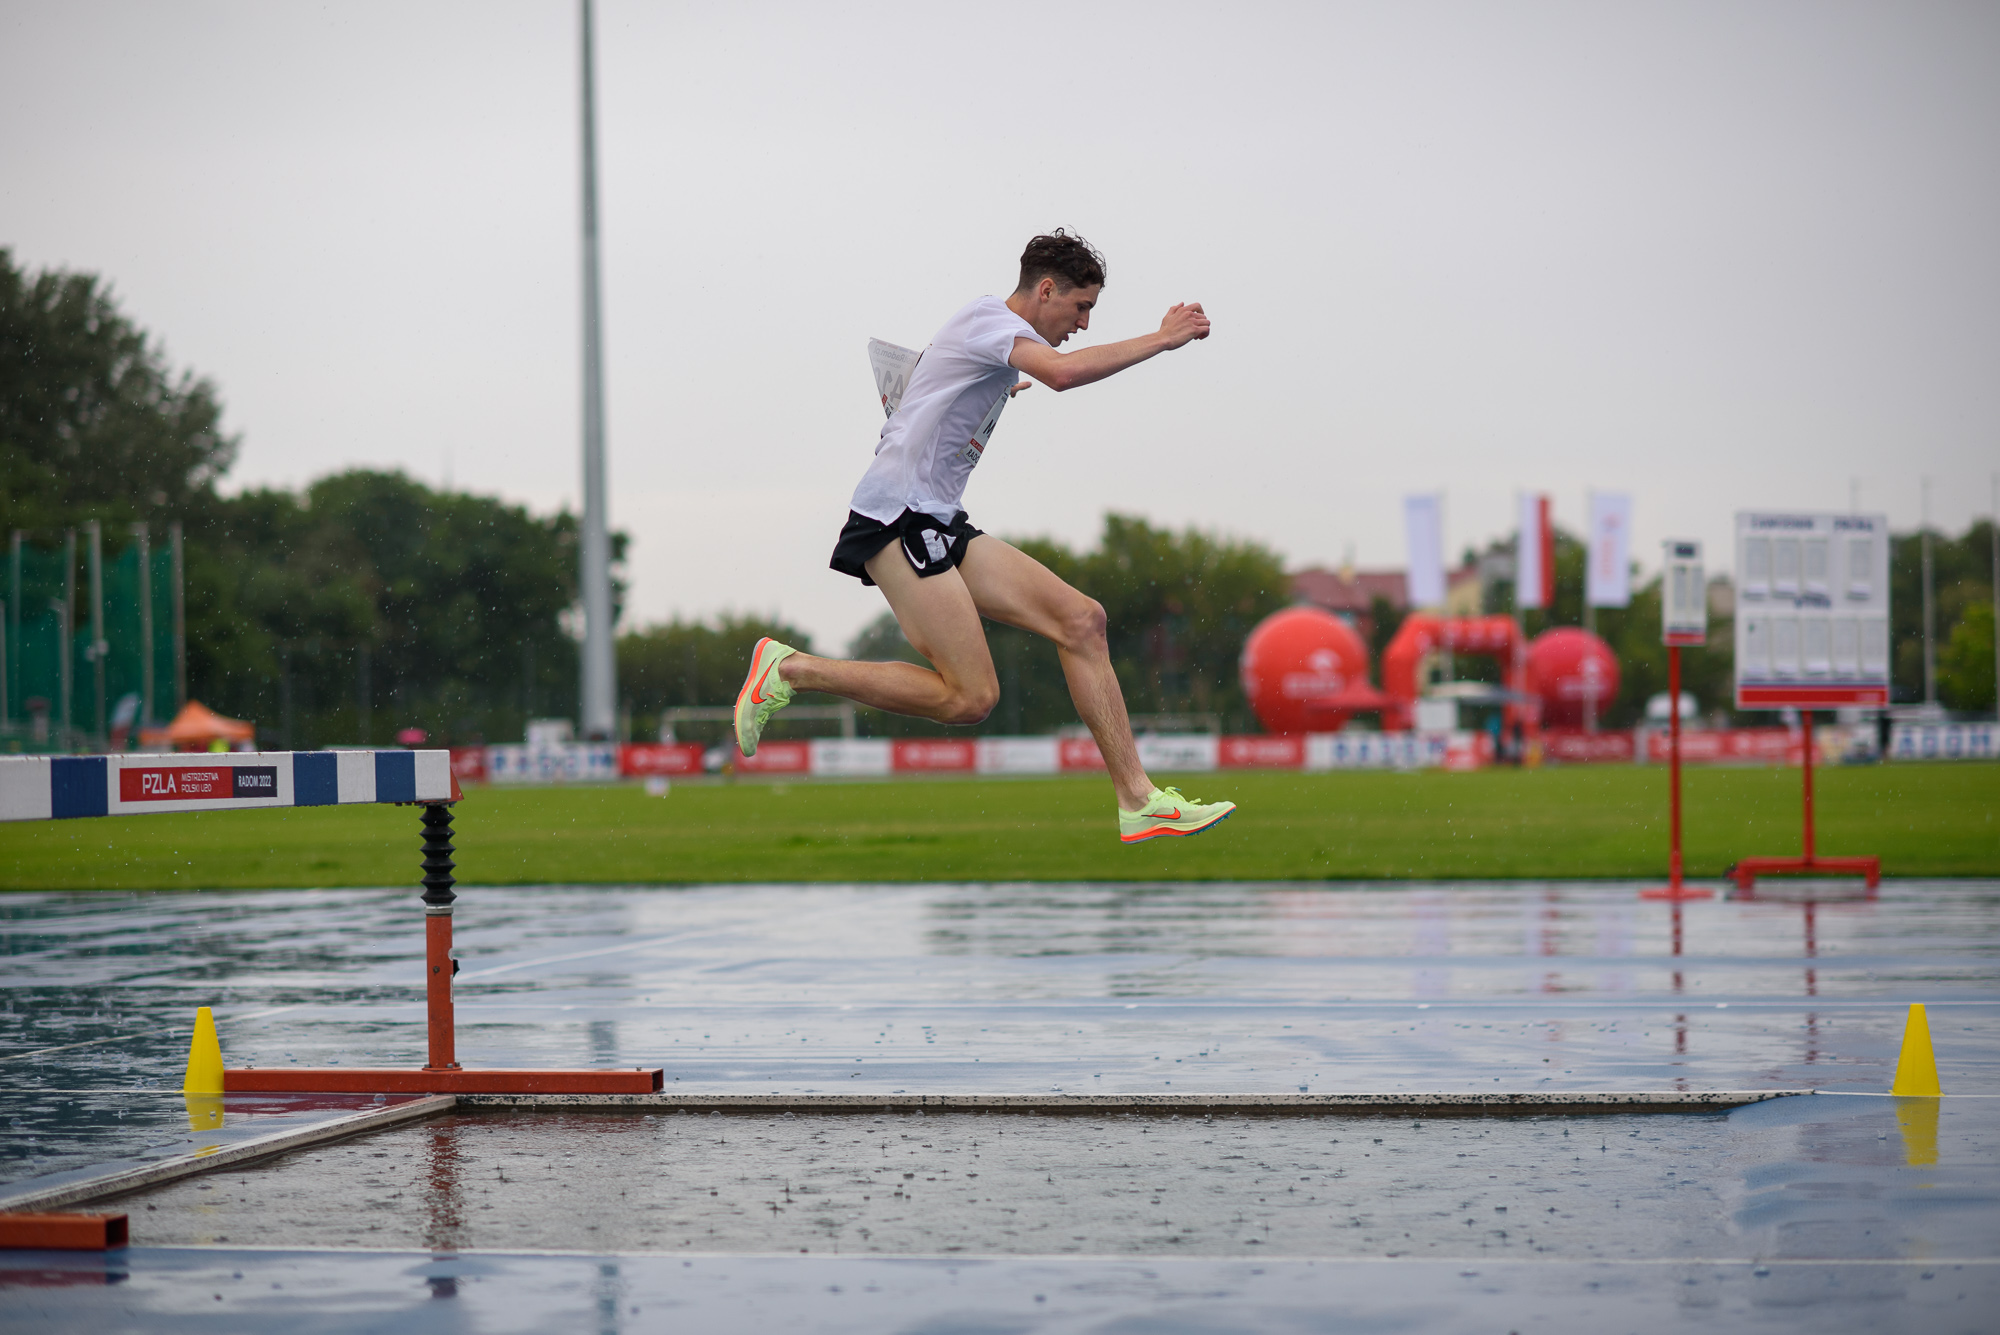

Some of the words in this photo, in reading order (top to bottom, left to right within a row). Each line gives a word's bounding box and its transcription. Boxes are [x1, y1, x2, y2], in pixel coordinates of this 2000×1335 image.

[181, 772, 220, 782] MISTRZOSTWA
[238, 774, 259, 787] RADOM
[259, 775, 272, 787] 2022
[142, 773, 177, 794] PZLA
[181, 783, 200, 793] POLSKI
[200, 783, 213, 793] U20
